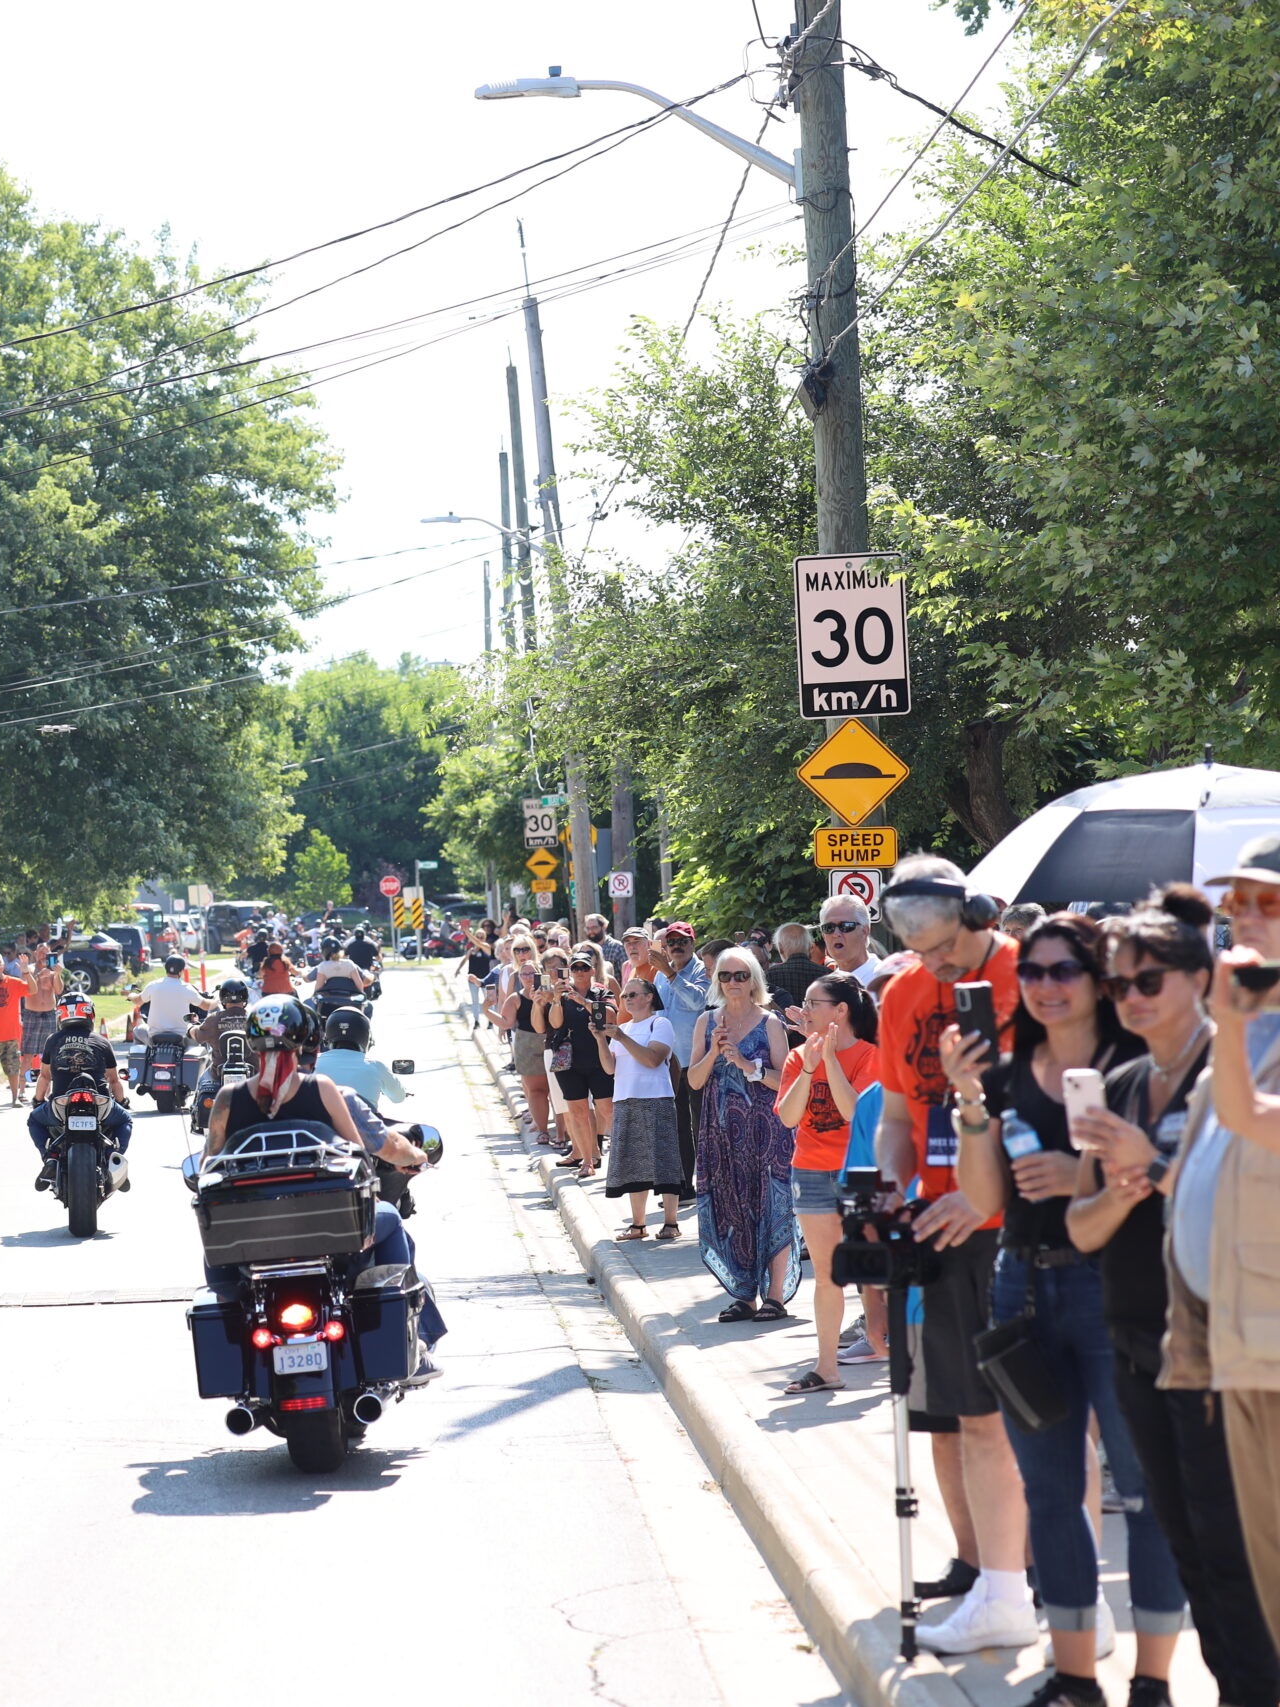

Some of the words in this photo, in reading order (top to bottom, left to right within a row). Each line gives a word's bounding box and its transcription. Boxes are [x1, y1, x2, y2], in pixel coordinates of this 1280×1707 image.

[805, 570, 894, 592] MAXIMUM
[811, 607, 894, 668] 30
[812, 684, 898, 712] km/h
[528, 814, 552, 832] 30
[528, 837, 555, 846] km/h
[827, 833, 884, 847] SPEED
[831, 848, 881, 862] HUMP
[381, 882, 400, 891] STOP
[65, 1035, 89, 1044] HOGS
